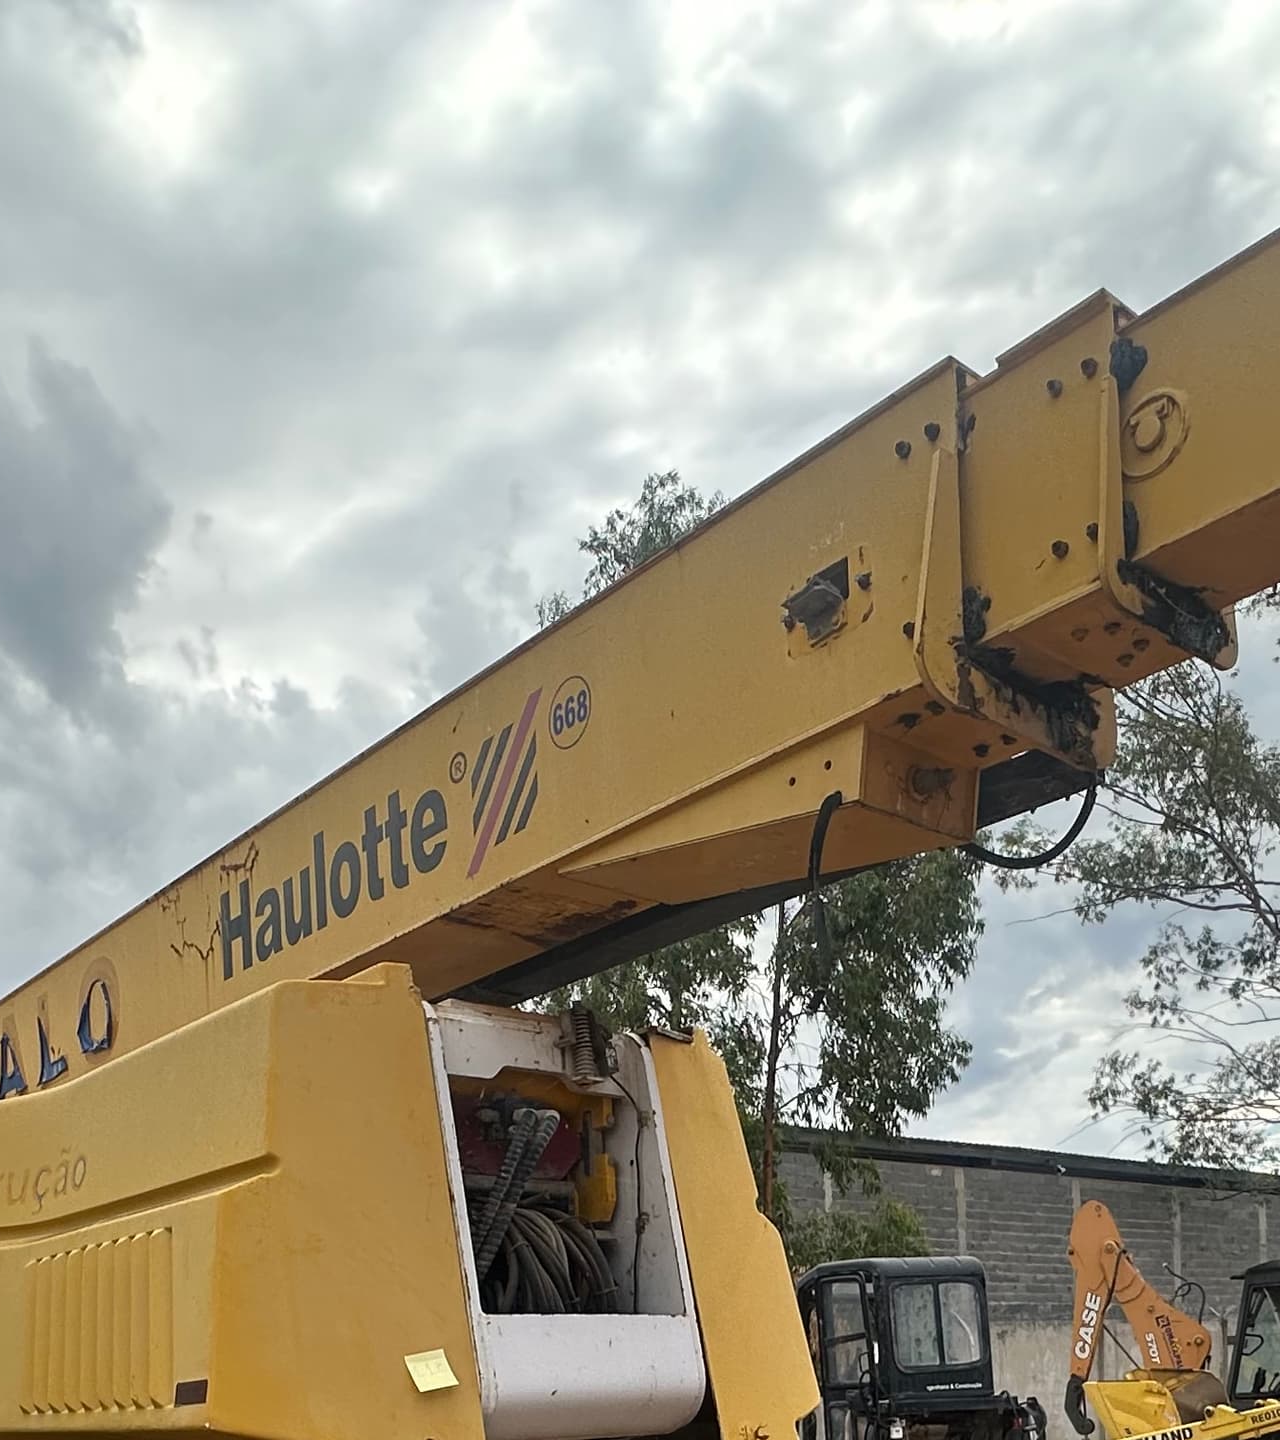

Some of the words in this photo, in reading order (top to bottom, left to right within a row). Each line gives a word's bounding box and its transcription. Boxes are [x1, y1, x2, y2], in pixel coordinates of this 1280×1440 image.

[551, 688, 589, 737] 668
[219, 787, 448, 983] Haulotte
[1074, 1291, 1101, 1360] CASE
[1144, 1331, 1161, 1365] 570T
